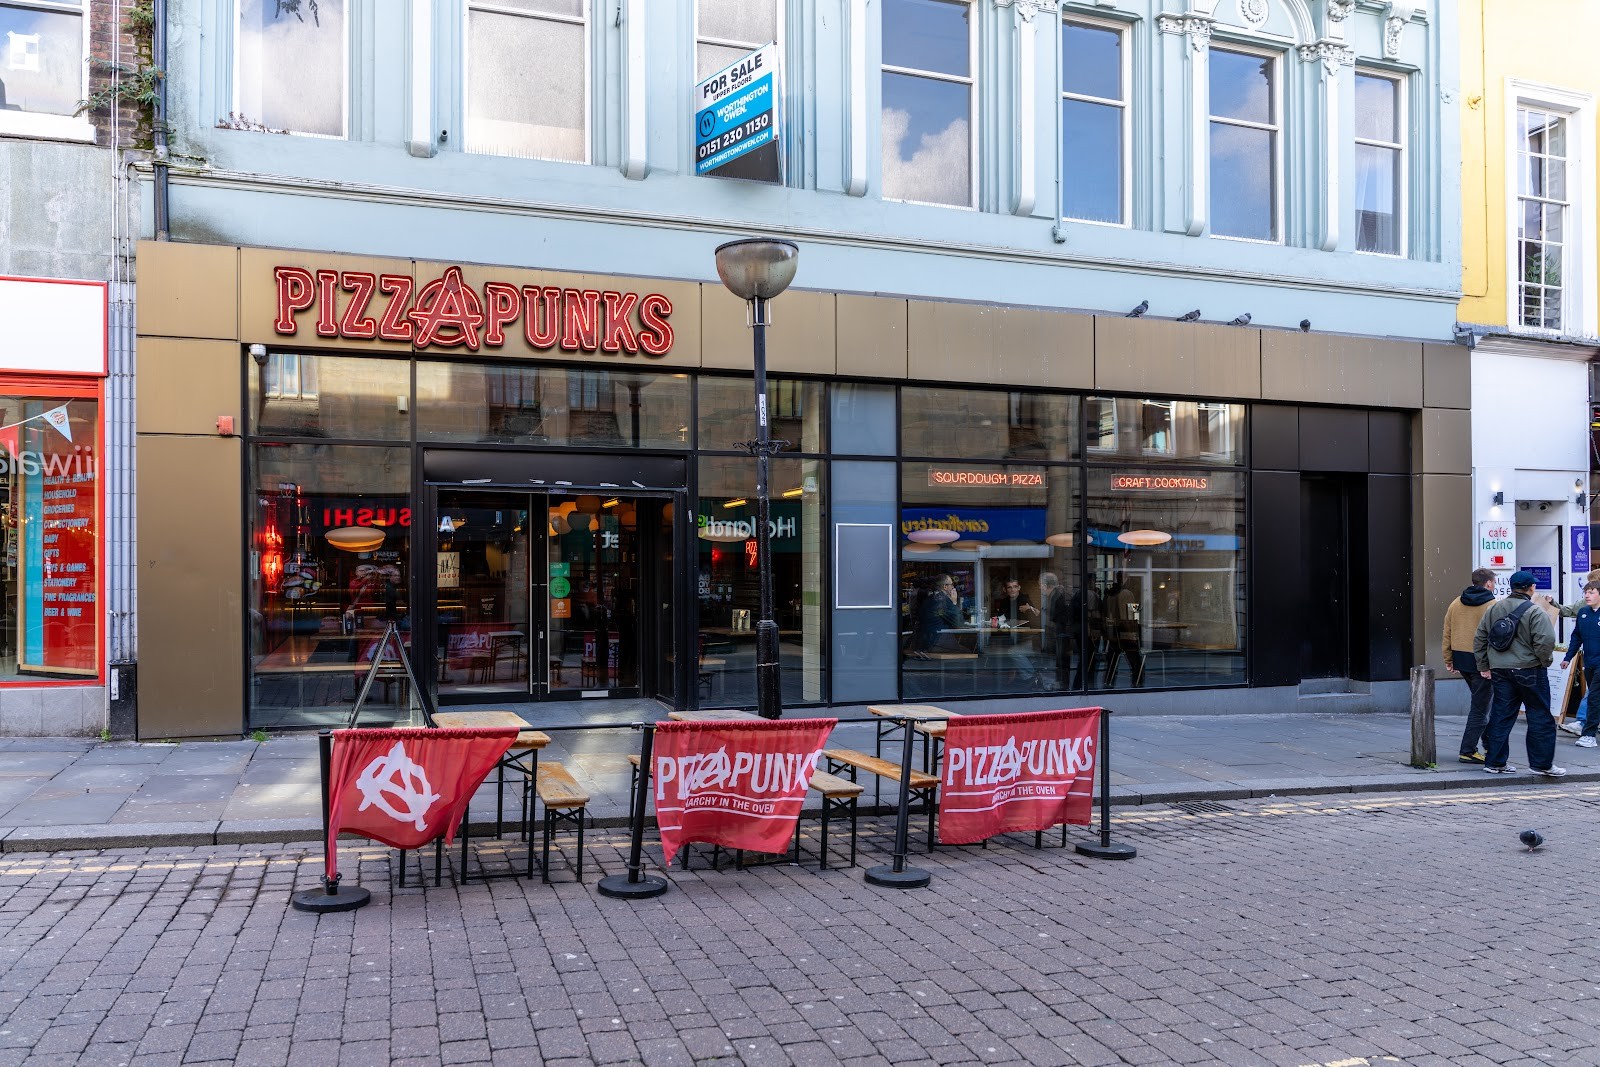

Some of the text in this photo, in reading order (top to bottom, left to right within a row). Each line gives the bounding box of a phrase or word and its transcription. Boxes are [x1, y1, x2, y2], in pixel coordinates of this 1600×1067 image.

[703, 53, 763, 98] FOR SALE
[712, 75, 753, 101] UPPER FLOORS
[717, 83, 769, 118] WORTHINGTON
[699, 113, 769, 158] 0151 230 1130
[699, 131, 769, 171] WORTHINGTONOWEN.COM
[273, 265, 675, 356] PIZZA PUNKS
[44, 475, 65, 485] HEALTH
[935, 472, 1042, 485] SOURDOUGH PIZZA
[1118, 477, 1207, 489] CRAFT COCKTAILS
[44, 489, 77, 500] HOUSEHOLD
[44, 504, 75, 514] GROCERIES
[1488, 526, 1508, 538] café
[44, 534, 59, 543] BABY
[1482, 537, 1514, 550] latino
[44, 549, 60, 558] GIFTS
[44, 563, 58, 572] TOYS
[66, 563, 87, 572] GAMES
[44, 578, 77, 587] STATIONERY
[44, 593, 96, 602] FINE FRAGRANCES
[44, 607, 59, 616] BEER
[67, 607, 82, 616] WINE
[1016, 736, 1093, 777] PUNKS
[1017, 785, 1034, 796] THE
[1035, 785, 1056, 795] OVEN
[719, 797, 730, 807] IN
[732, 799, 750, 811] THE
[752, 803, 776, 814] OVEN
